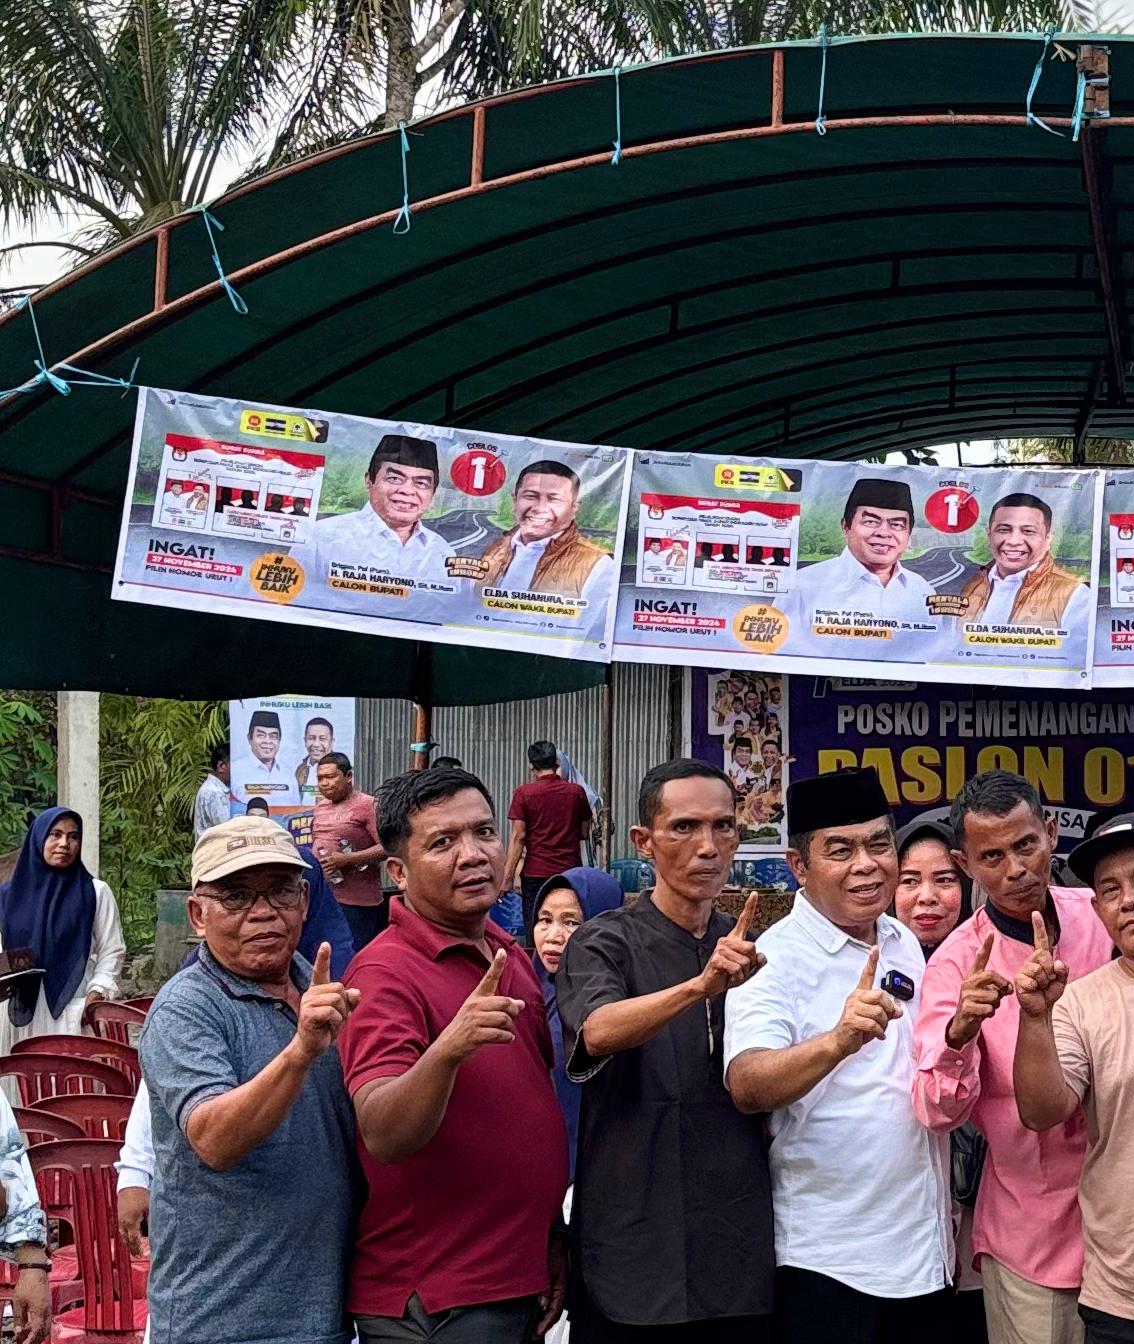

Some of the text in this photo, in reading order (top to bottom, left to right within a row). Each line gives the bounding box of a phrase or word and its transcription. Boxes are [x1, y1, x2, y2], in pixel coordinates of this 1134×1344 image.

[471, 457, 486, 489] 1
[944, 494, 959, 526] 1
[149, 539, 215, 560] INGAT!
[164, 557, 212, 570] NOVEMBER
[256, 568, 299, 585] LEBIH
[331, 569, 340, 578] H.
[343, 571, 367, 582] RAJA
[370, 574, 416, 589] HARYONO,
[260, 582, 290, 593] BAIK
[332, 580, 404, 596] CALON BUPATI
[485, 589, 508, 598] ELDA
[488, 600, 575, 615] CALON WAKIL BUPATI
[634, 599, 697, 615] INGAT!
[638, 614, 647, 622] 27
[650, 615, 696, 624] NOVEMBER
[827, 617, 851, 626] RAJA
[854, 619, 900, 630] HARYONO,
[739, 622, 782, 634] LEBIH
[816, 627, 887, 638] CALON BUPATI
[966, 625, 988, 633] ELDA
[745, 633, 775, 643] BAIK
[969, 636, 998, 644] CALON
[1028, 638, 1056, 646] BUPATI
[837, 701, 930, 736] POSKO
